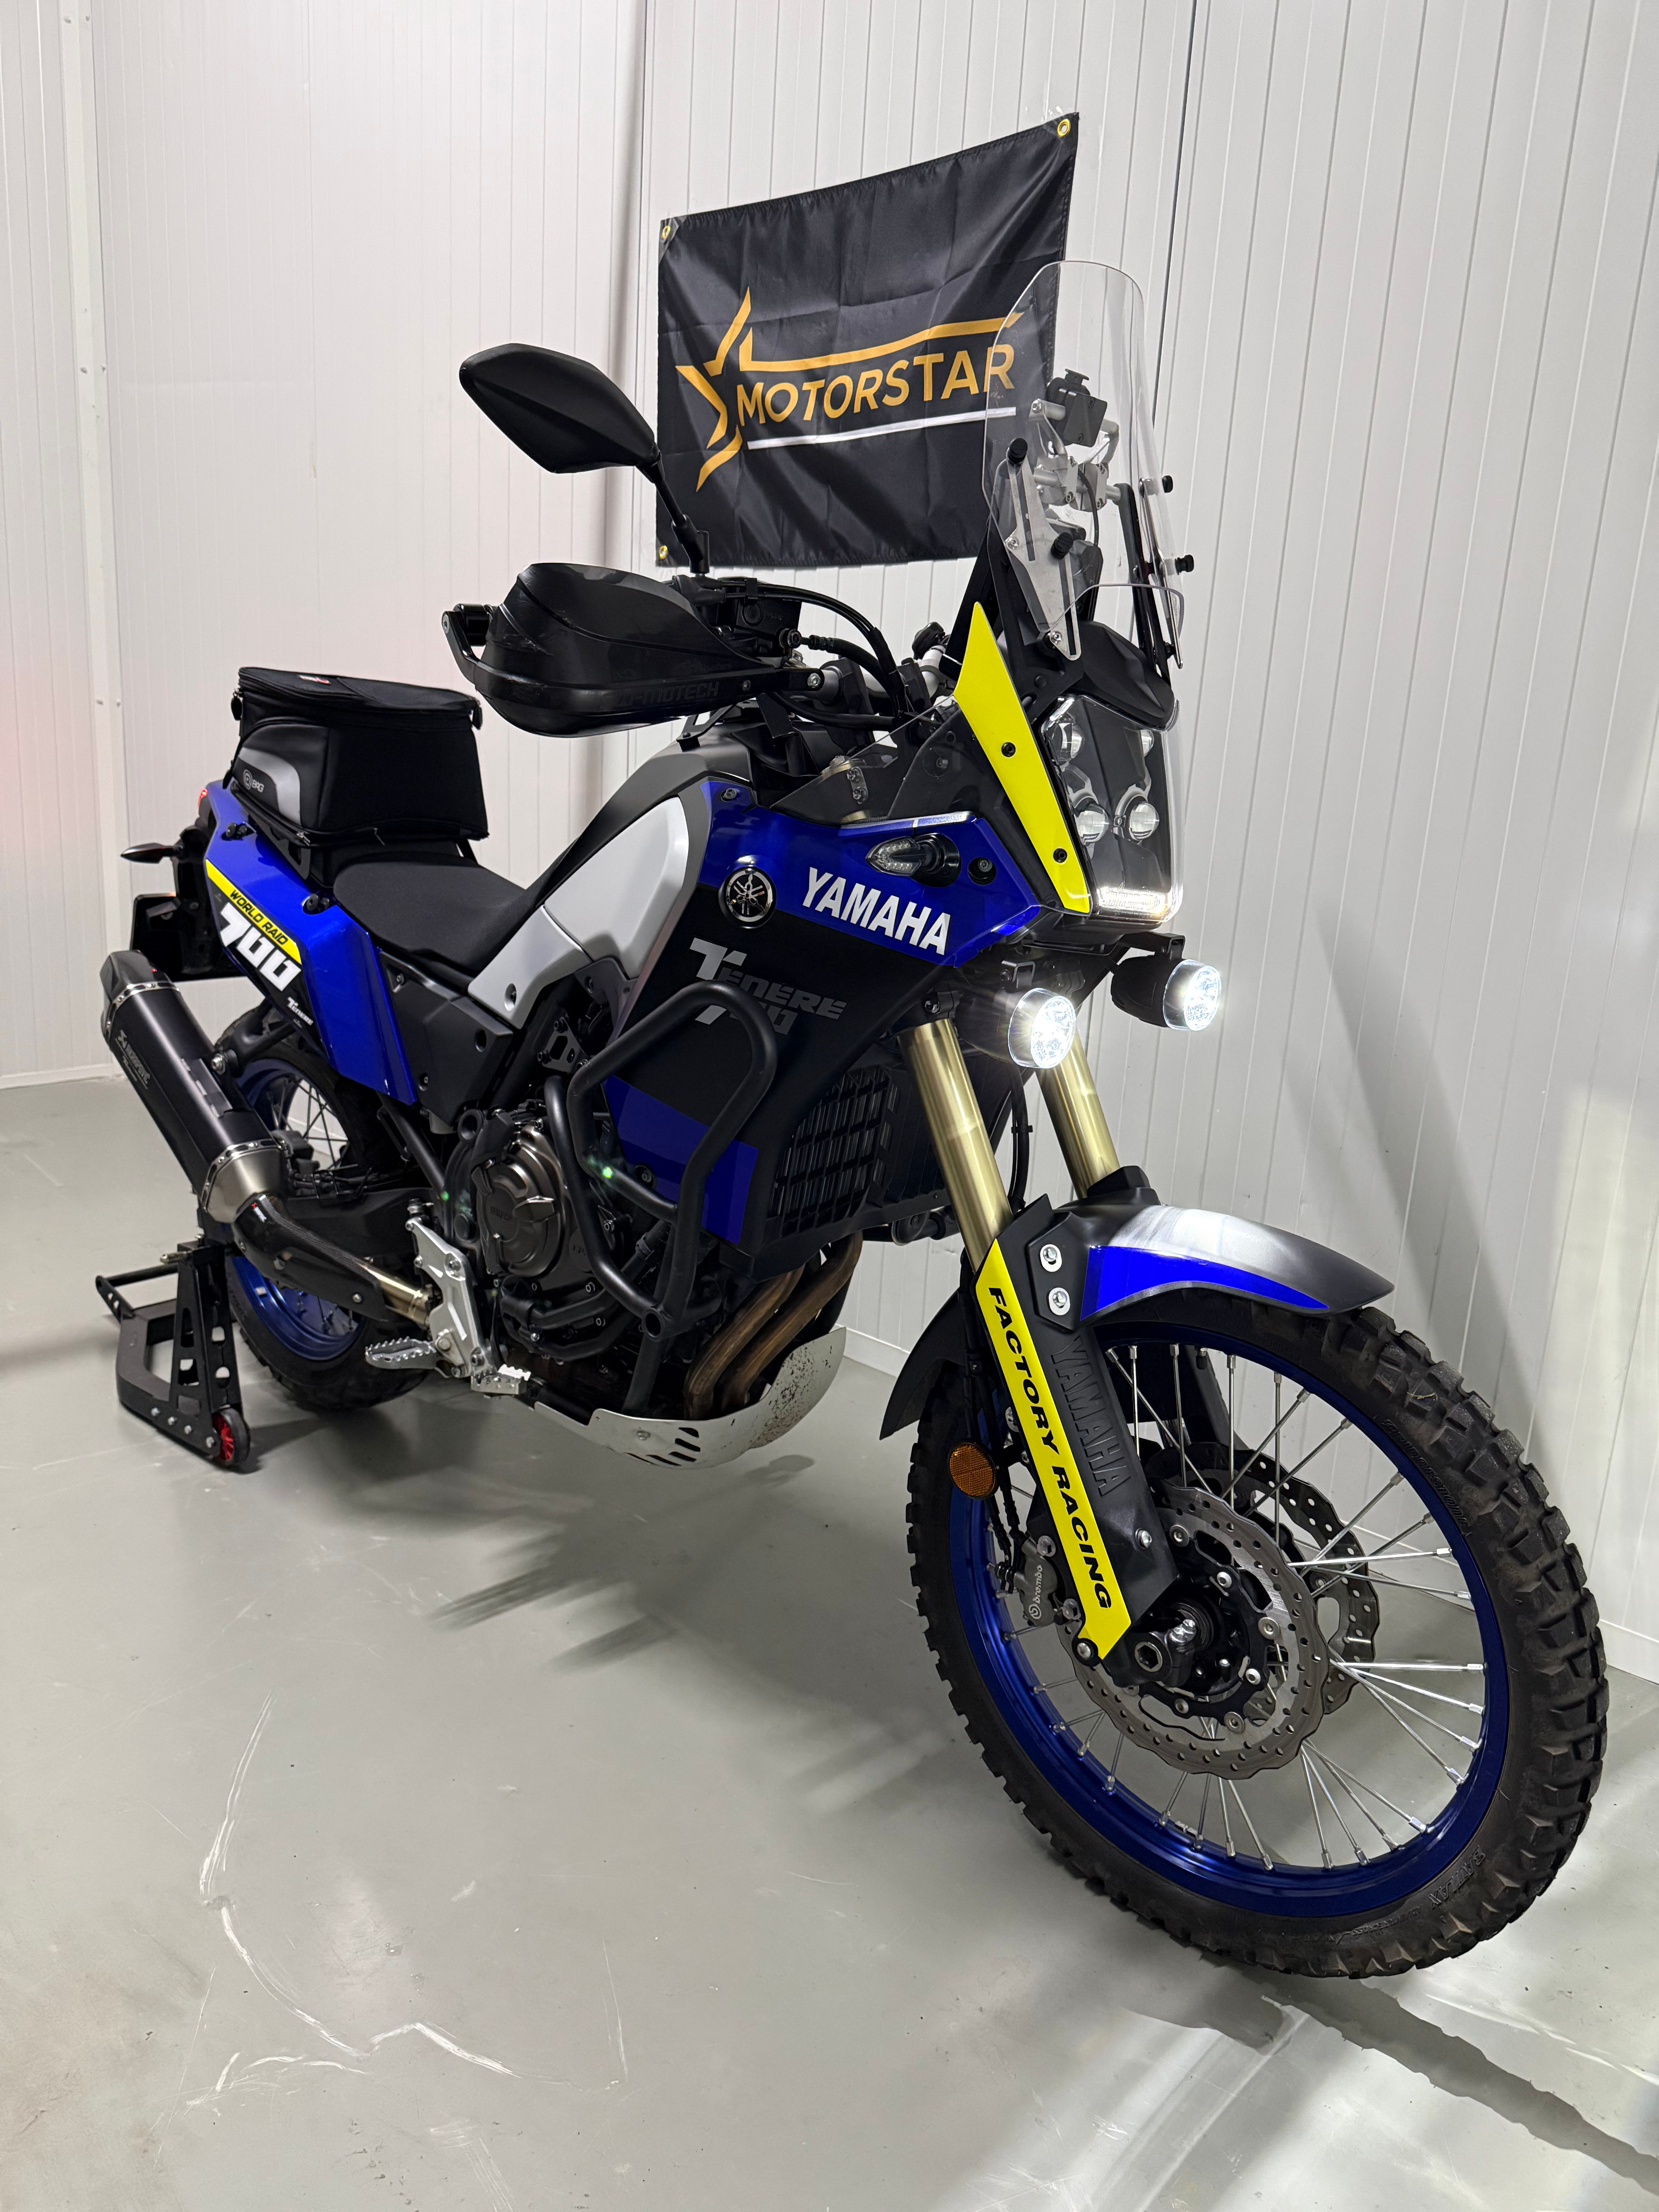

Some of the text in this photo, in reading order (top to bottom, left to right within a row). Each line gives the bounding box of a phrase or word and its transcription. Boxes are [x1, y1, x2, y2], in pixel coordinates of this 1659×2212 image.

[736, 343, 1015, 427] MOTORSTAR
[220, 902, 302, 992] 700
[230, 890, 289, 945] WORLD RAID
[802, 867, 951, 955] YAMAHA
[988, 1287, 1111, 1609] FACTORY RACING
[1051, 1335, 1132, 1497] YAMAHA
[1032, 1564, 1043, 1604] brembo
